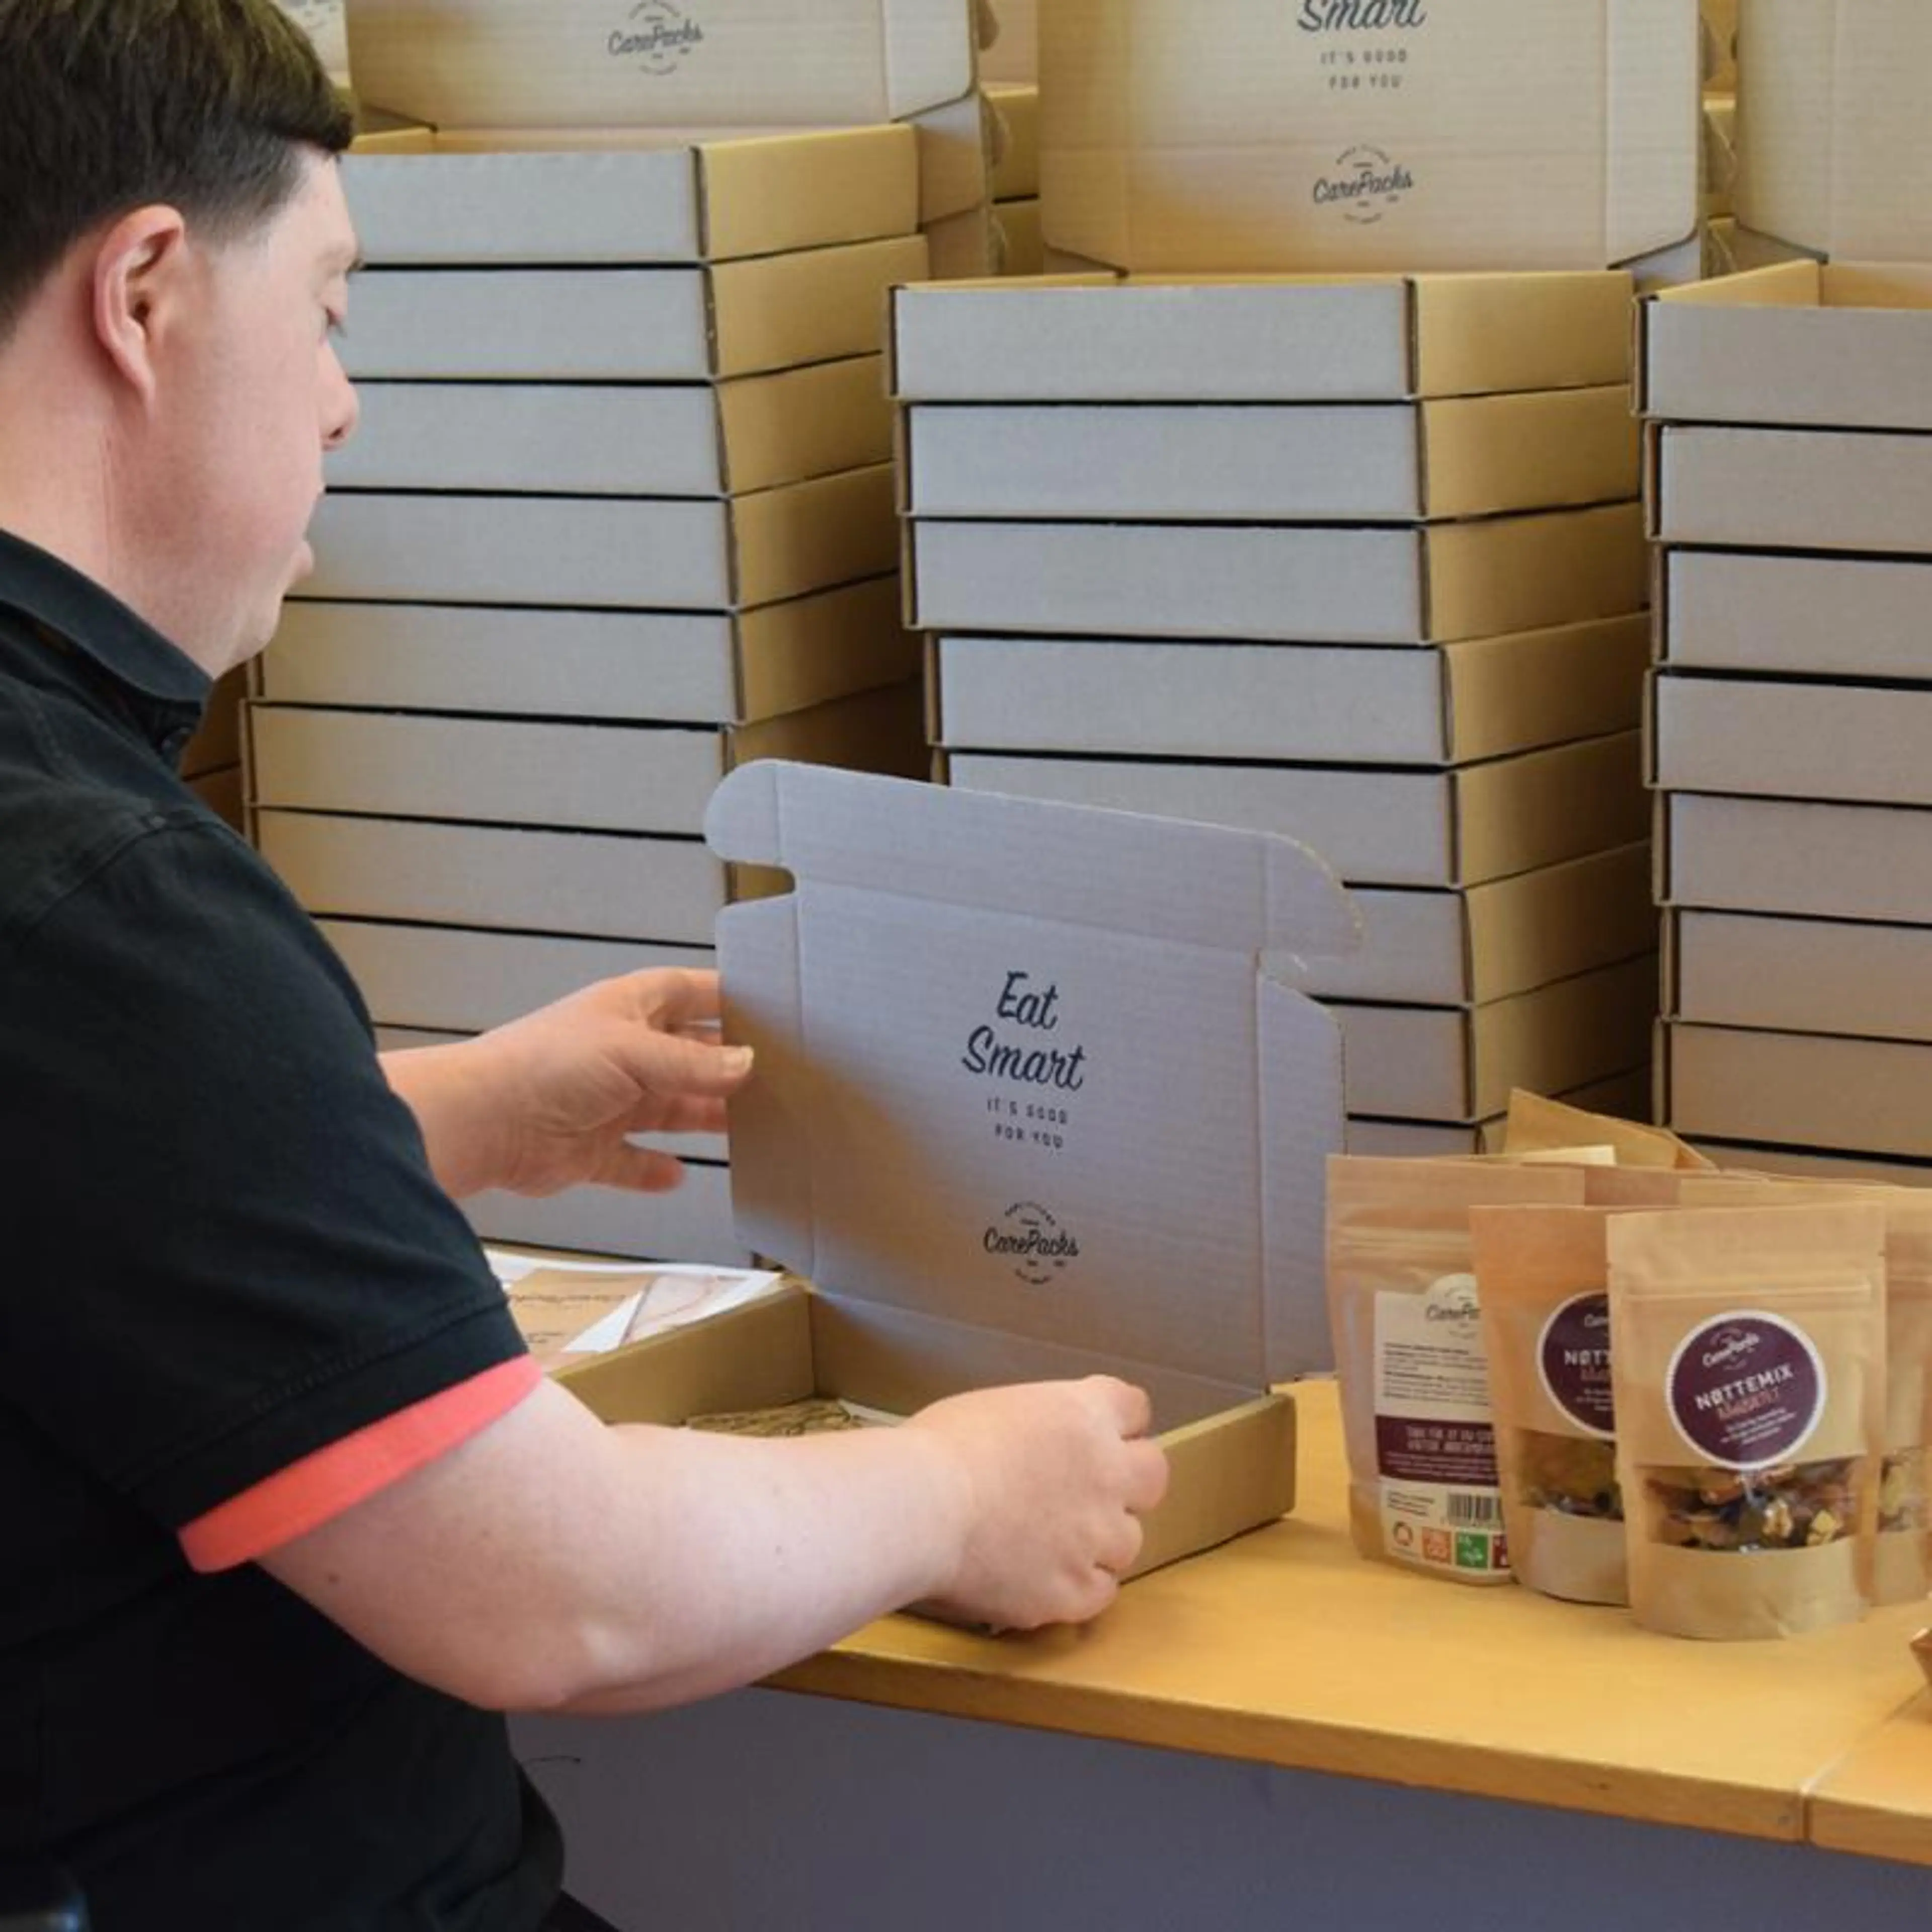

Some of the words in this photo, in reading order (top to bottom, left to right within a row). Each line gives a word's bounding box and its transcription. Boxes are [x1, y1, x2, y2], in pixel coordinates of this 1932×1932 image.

[1328, 74, 1360, 90] FOR
[1369, 73, 1403, 89] YOU
[1312, 164, 1415, 204] CarePacks
[996, 970, 1059, 1030] Eat
[961, 1024, 1087, 1091] Smart
[995, 1123, 1025, 1141] FOR
[1032, 1131, 1064, 1150] YOU
[983, 1226, 1080, 1257] CarePacks
